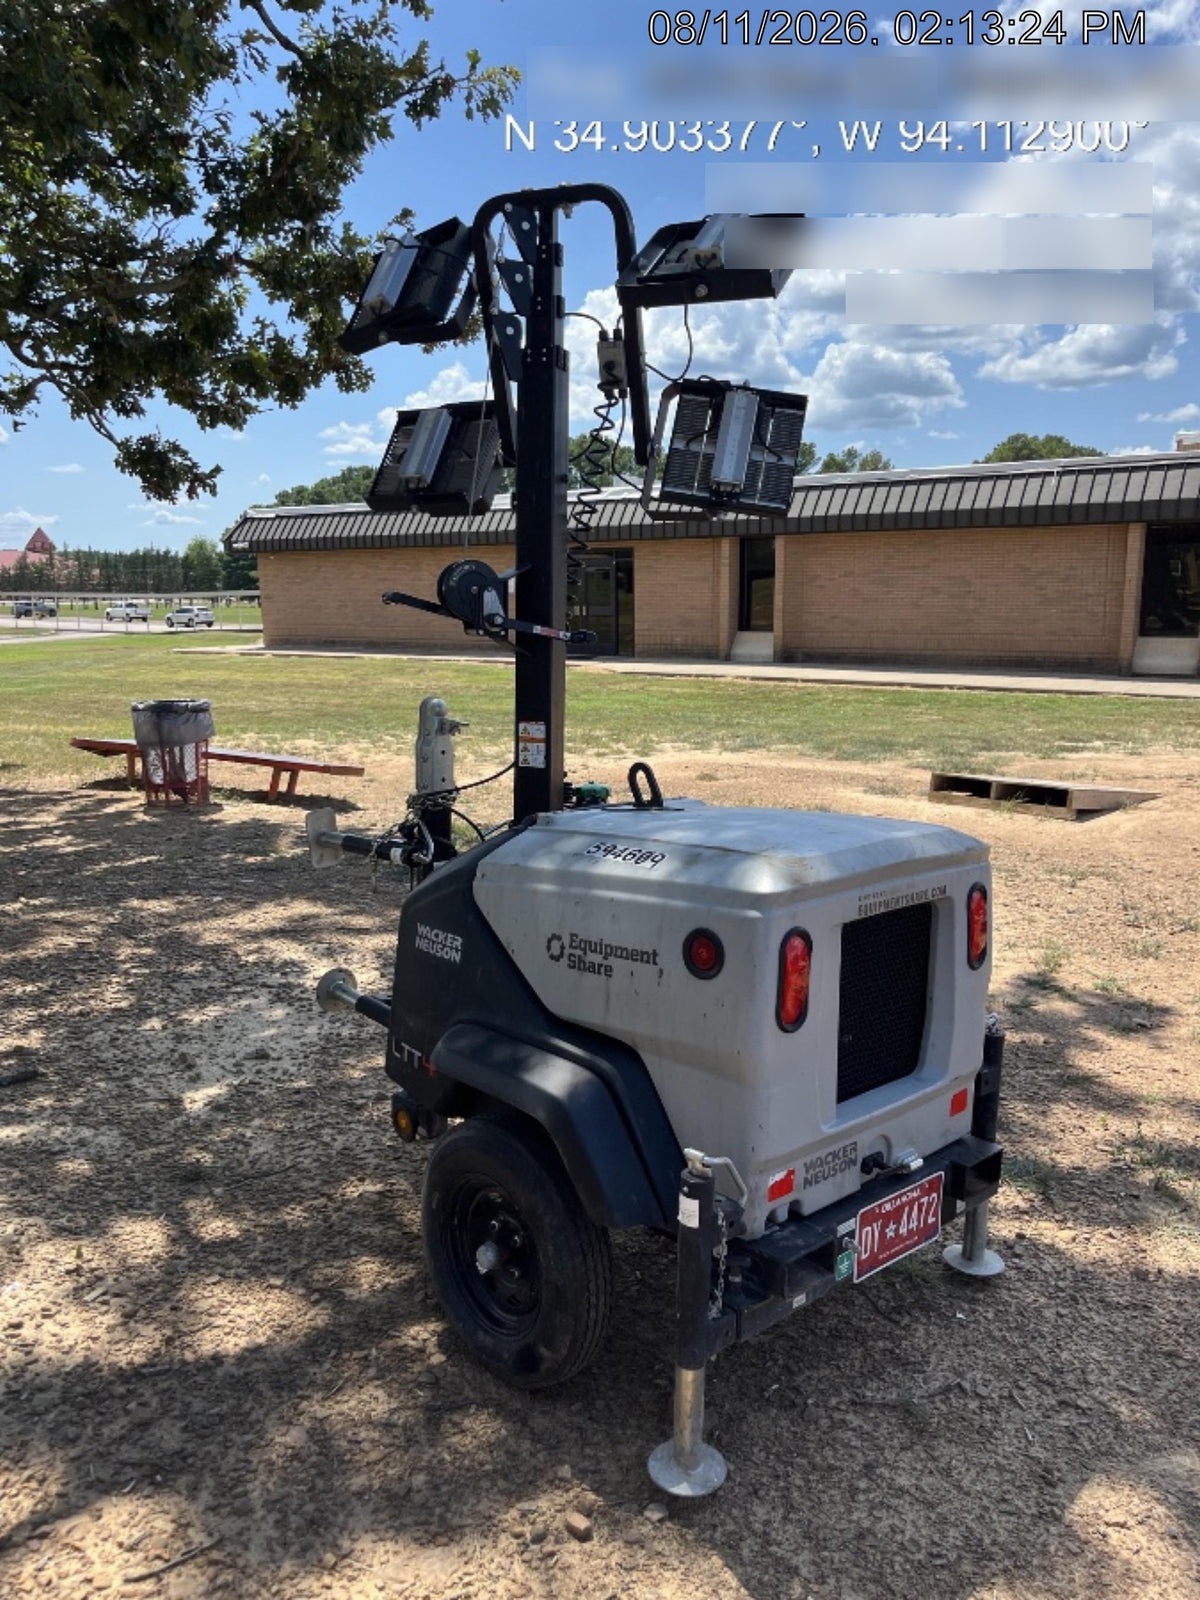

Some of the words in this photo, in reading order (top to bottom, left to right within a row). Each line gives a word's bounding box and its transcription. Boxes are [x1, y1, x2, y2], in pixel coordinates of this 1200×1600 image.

[415, 936, 461, 963] NEUSON
[417, 922, 462, 950] WACKER
[568, 933, 659, 966] Equipment
[567, 953, 614, 978] Share
[803, 1141, 858, 1175] WACKER
[803, 1156, 858, 1190] NEUSON
[861, 1219, 883, 1259] DY
[899, 1192, 938, 1237] 4472
